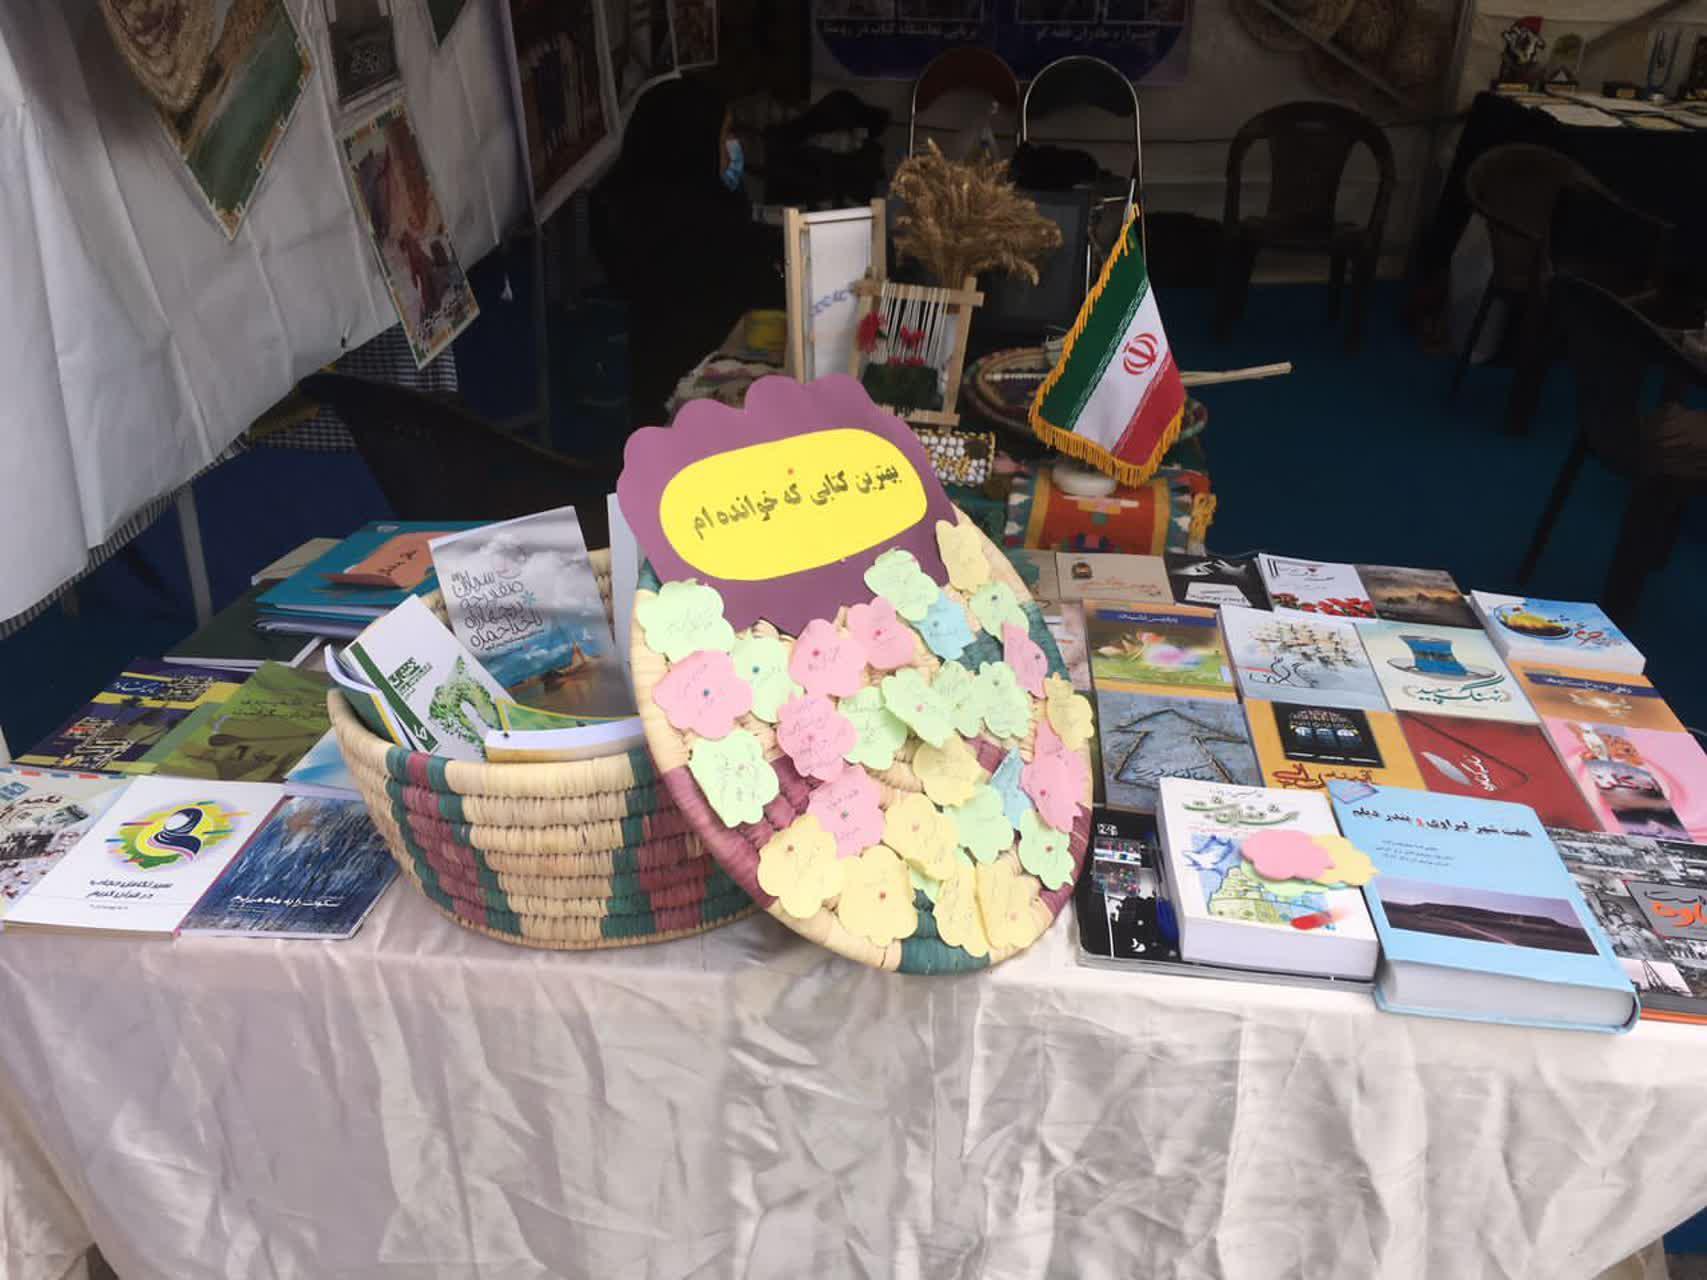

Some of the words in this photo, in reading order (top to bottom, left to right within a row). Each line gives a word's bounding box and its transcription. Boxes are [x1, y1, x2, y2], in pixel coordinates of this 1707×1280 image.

[783, 482, 802, 504] که
[810, 470, 849, 506] کتابی
[855, 464, 902, 493] بهترین
[693, 506, 715, 540] ام
[716, 490, 778, 524] خوانده
